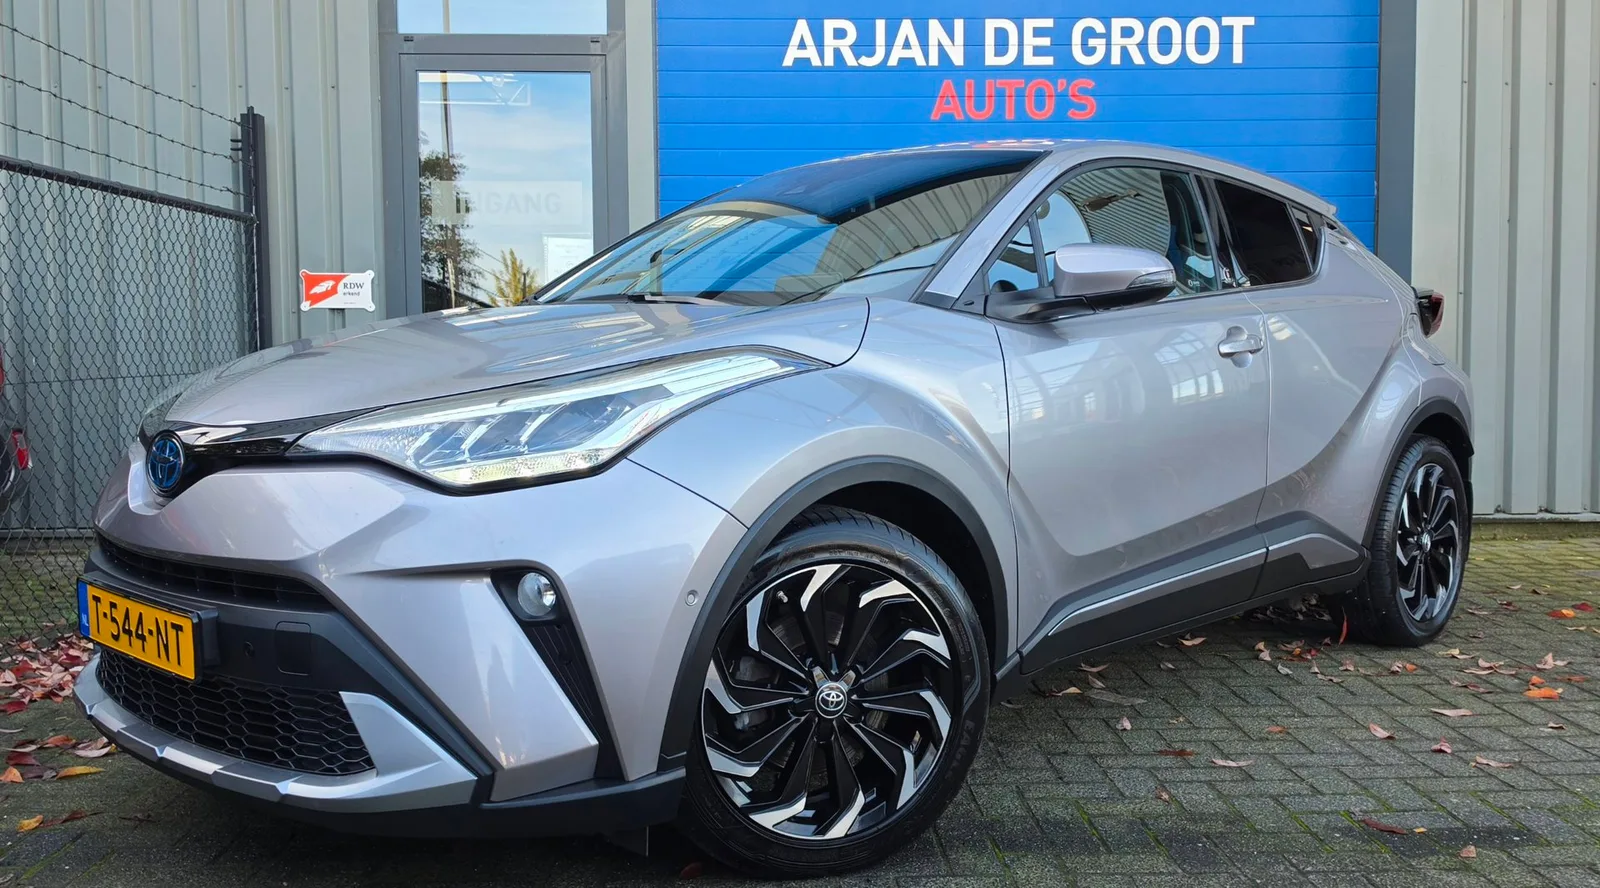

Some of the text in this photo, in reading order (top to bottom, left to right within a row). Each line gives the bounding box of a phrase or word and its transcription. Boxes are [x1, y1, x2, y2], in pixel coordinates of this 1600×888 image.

[782, 16, 1255, 67] ARJAN DE GROOT
[930, 79, 1097, 120] AUTO'S
[343, 282, 365, 290] RDW
[92, 594, 184, 667] T-544-NT
